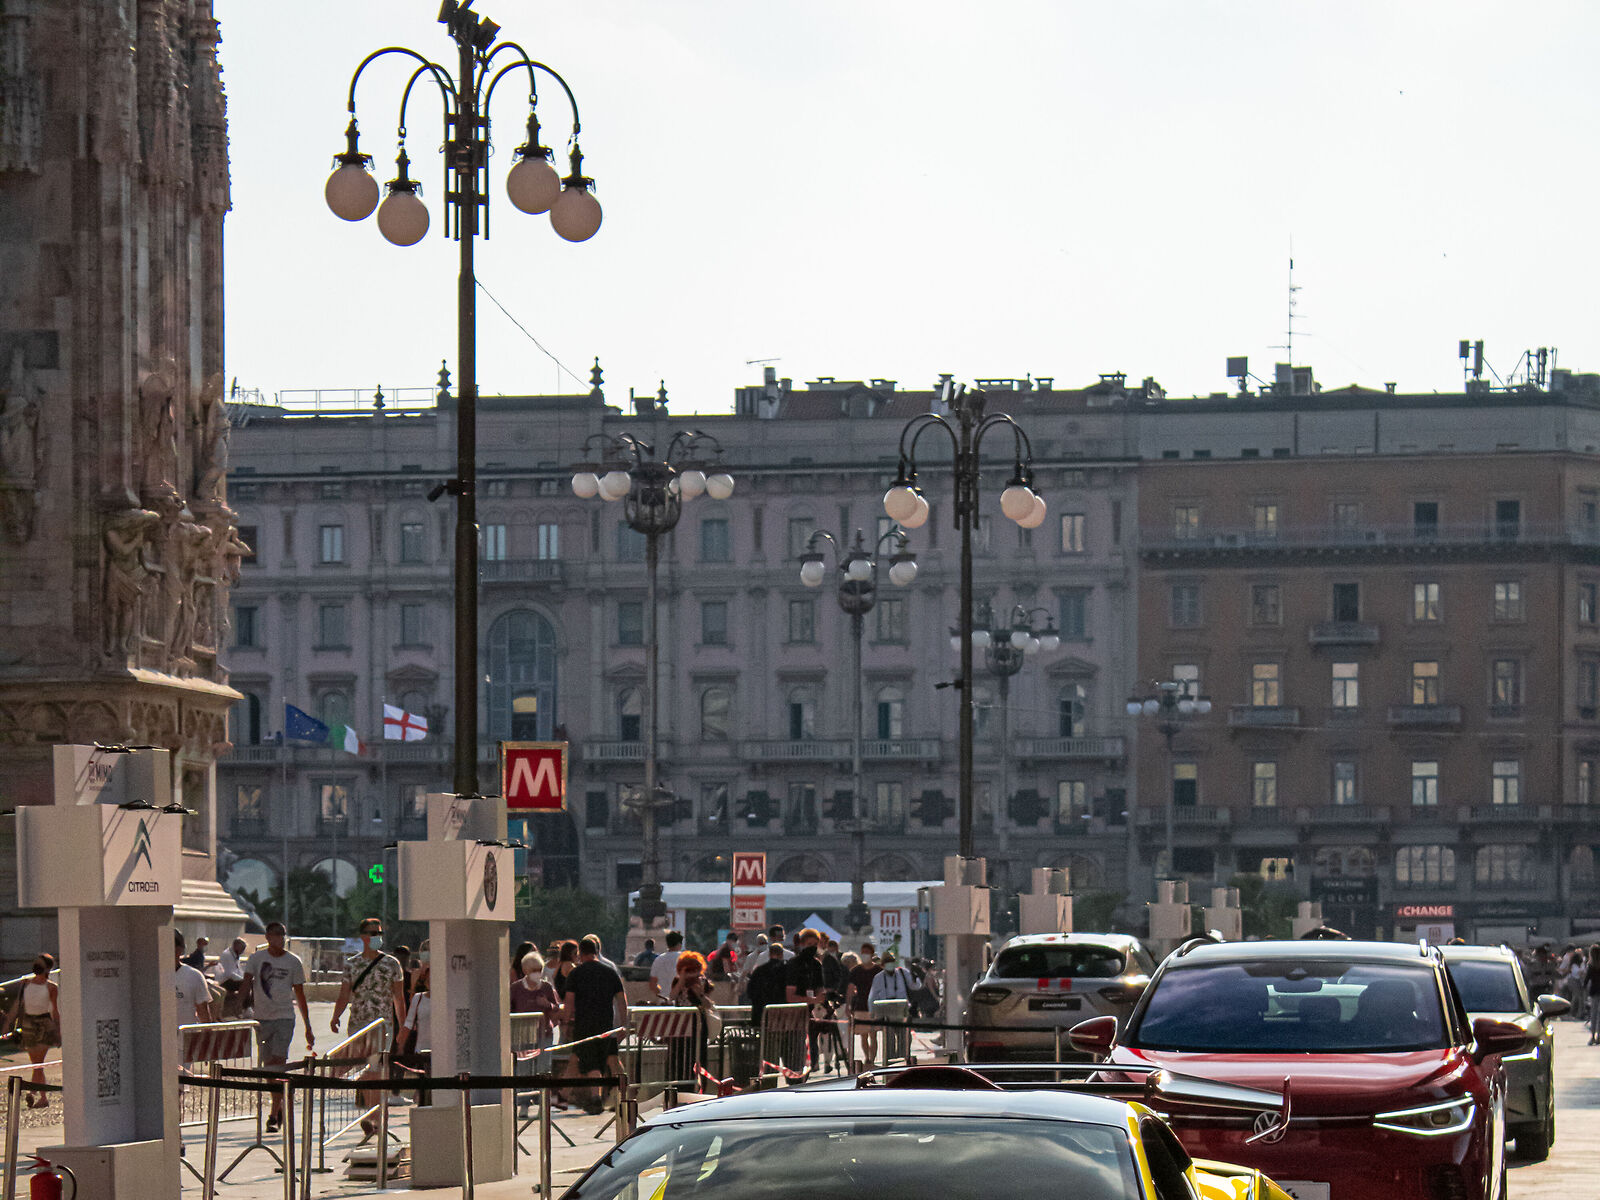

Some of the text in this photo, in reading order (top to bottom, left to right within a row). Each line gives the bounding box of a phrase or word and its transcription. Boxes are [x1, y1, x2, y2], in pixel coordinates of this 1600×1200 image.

[508, 757, 560, 797] M
[736, 860, 762, 880] M
[1403, 905, 1454, 916] CHANGE
